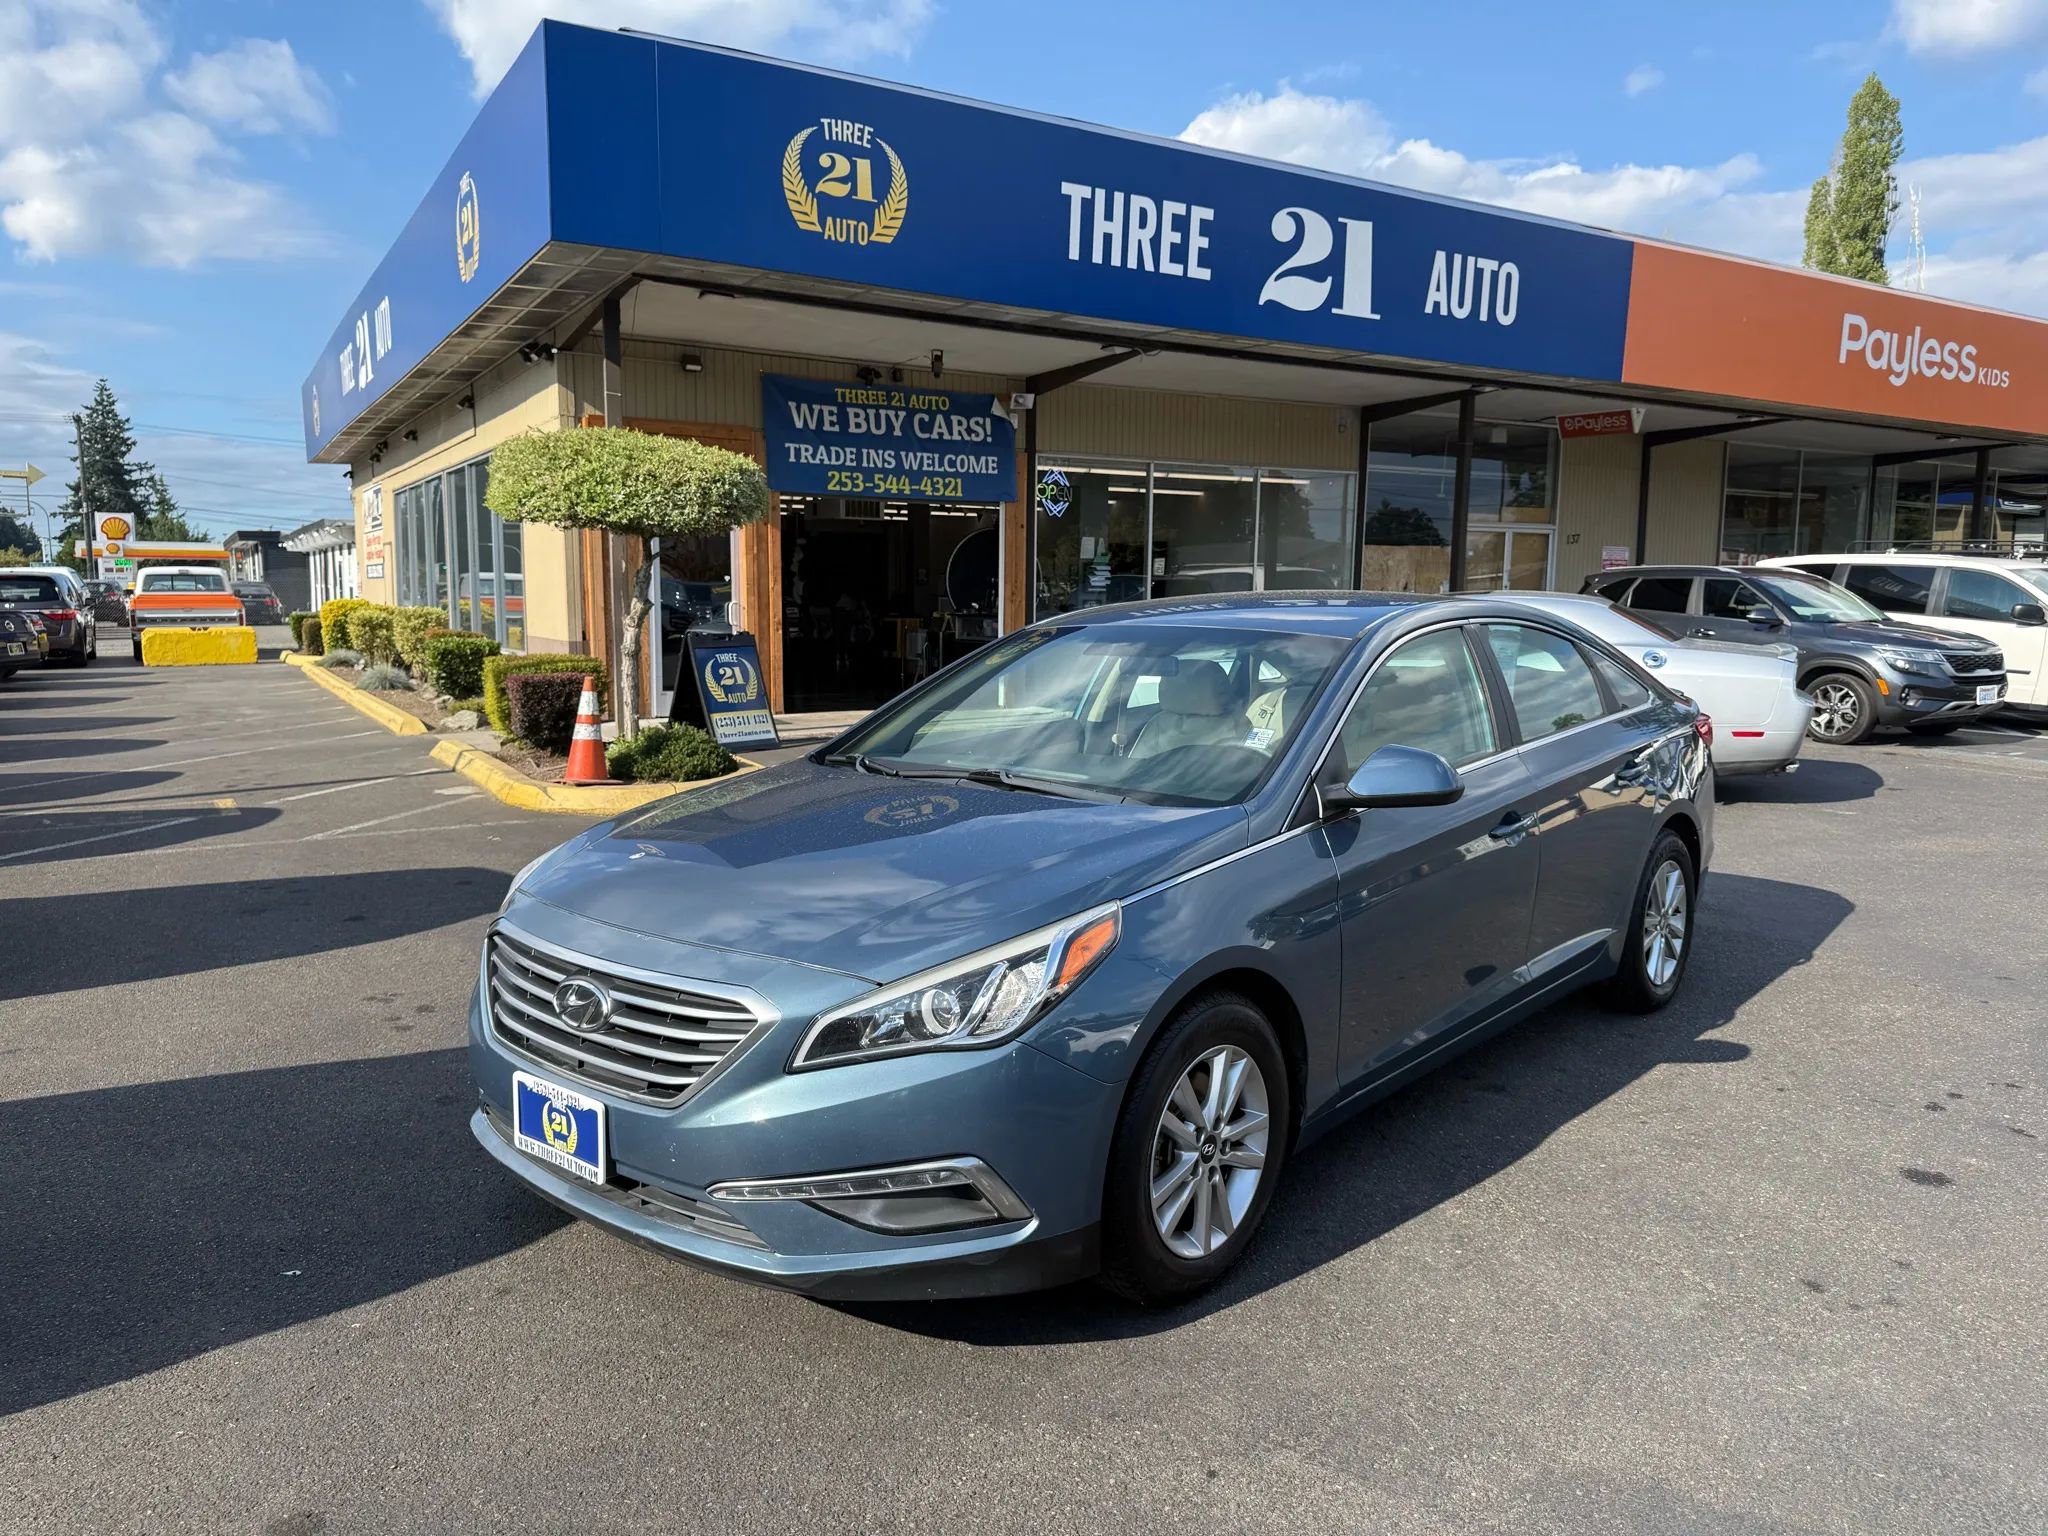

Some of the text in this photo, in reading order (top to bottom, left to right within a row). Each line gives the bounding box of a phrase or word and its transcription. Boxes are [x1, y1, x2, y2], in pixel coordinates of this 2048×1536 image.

[820, 118, 874, 148] THREE
[815, 152, 878, 203] 21
[460, 201, 474, 247] 21
[824, 216, 868, 246] AUTO
[1060, 181, 1520, 326] THREE 21 AUTO
[340, 295, 392, 397] THREE 21 AUTO
[1839, 313, 2010, 388] Payless KIDS
[834, 388, 949, 411] THREE 21 AUTO
[788, 401, 993, 443] WE BUY CARS!
[784, 442, 998, 475] TRADE INS WELCOME
[827, 471, 963, 497] 253-544-4321
[1036, 483, 1073, 503] OPEN
[715, 653, 738, 663] THREE
[718, 666, 747, 686] 21
[727, 692, 748, 704] AUTO
[551, 1111, 569, 1136] 21
